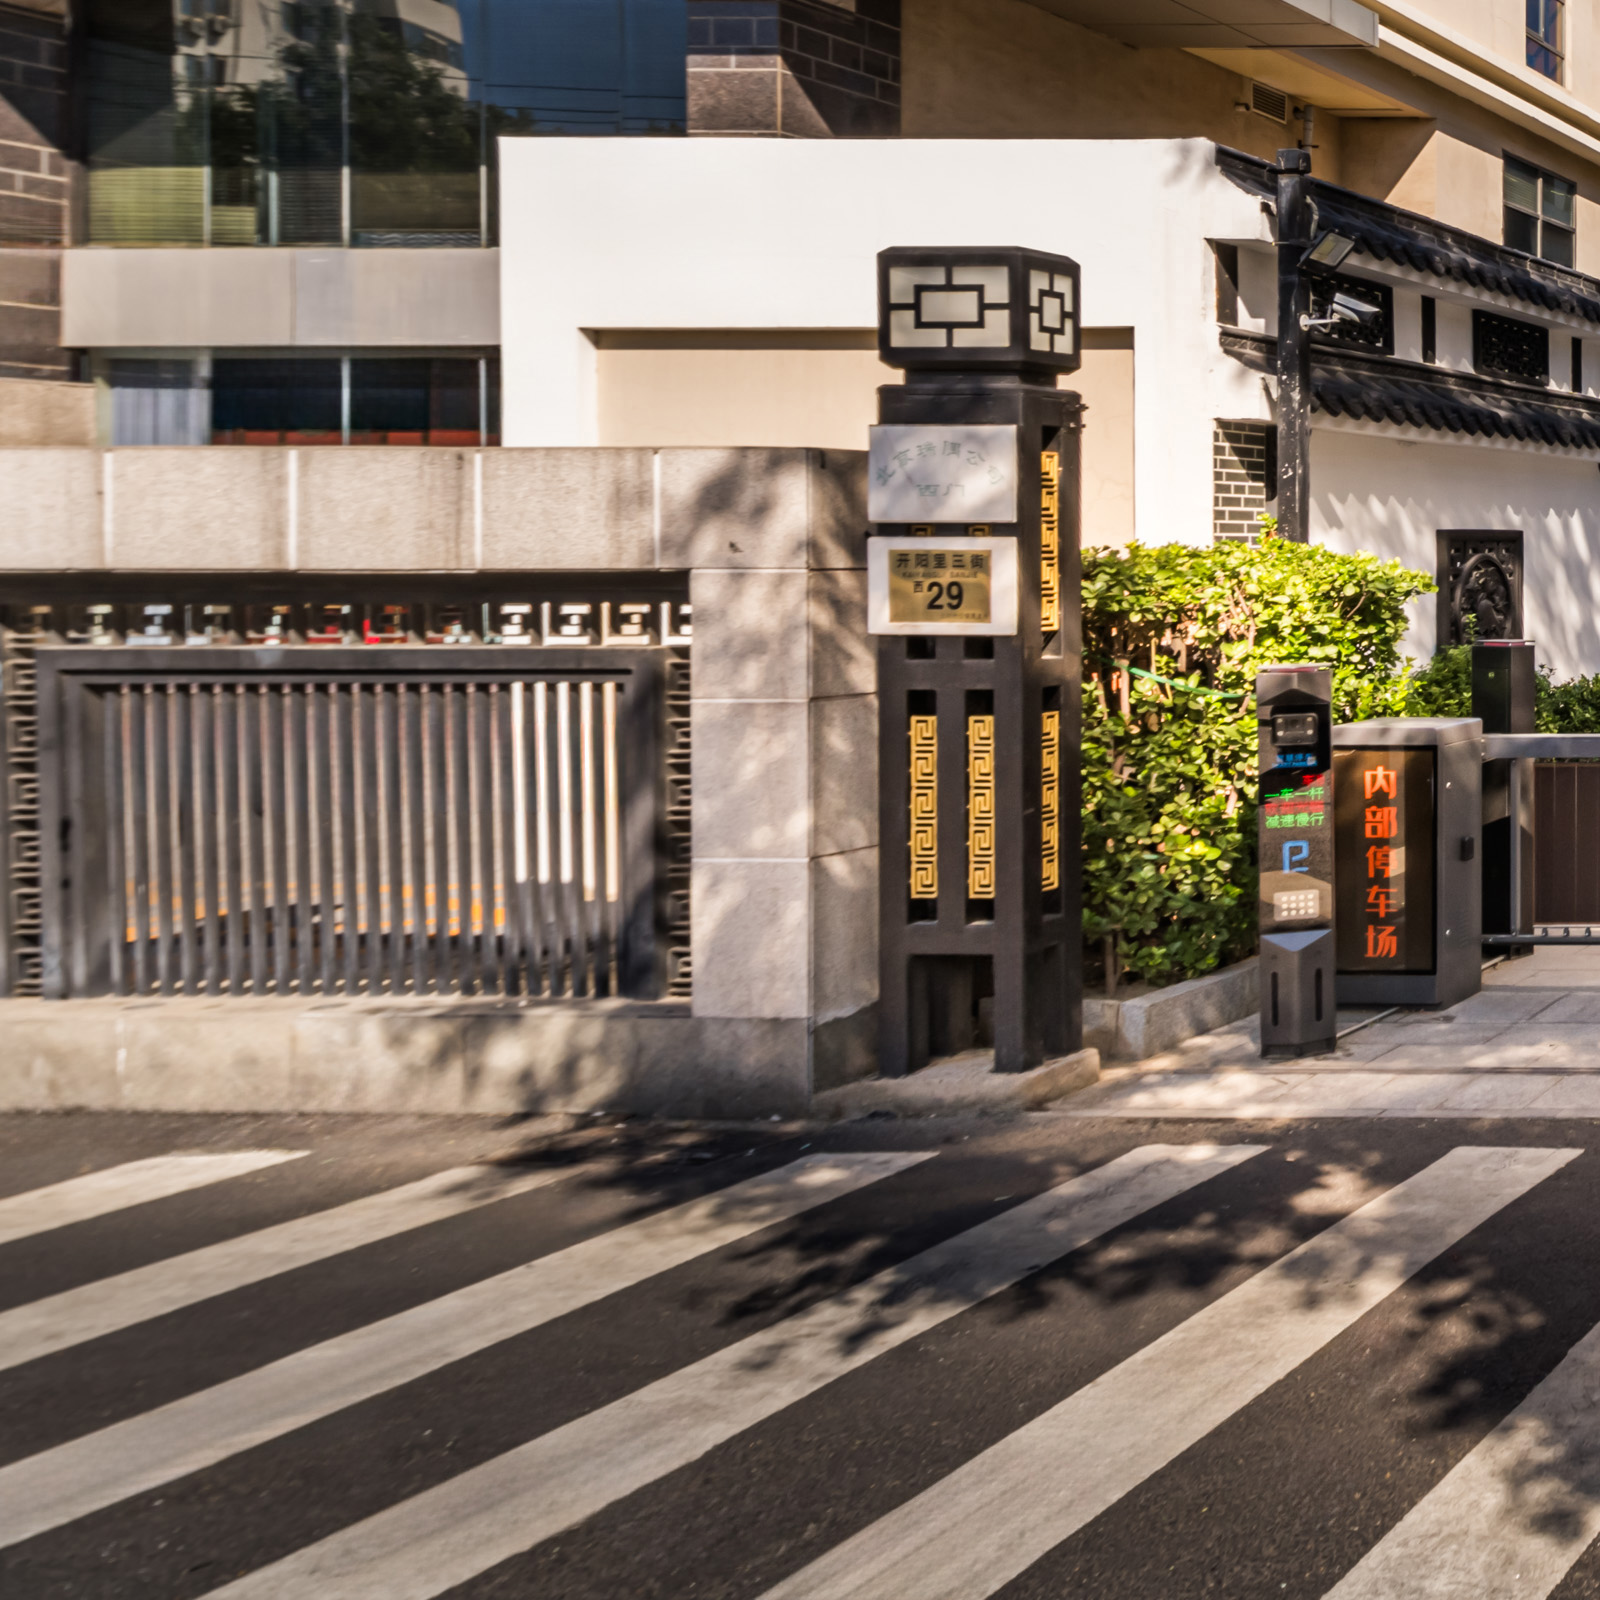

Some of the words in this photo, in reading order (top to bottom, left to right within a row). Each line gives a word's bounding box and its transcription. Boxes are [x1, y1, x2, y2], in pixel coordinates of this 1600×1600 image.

[896, 553, 985, 569] 开阳里三街
[926, 581, 964, 610] 29
[1264, 787, 1324, 802] 一车一杆
[1265, 812, 1325, 829] 减速慢行
[1363, 765, 1398, 958] 内部停车场
